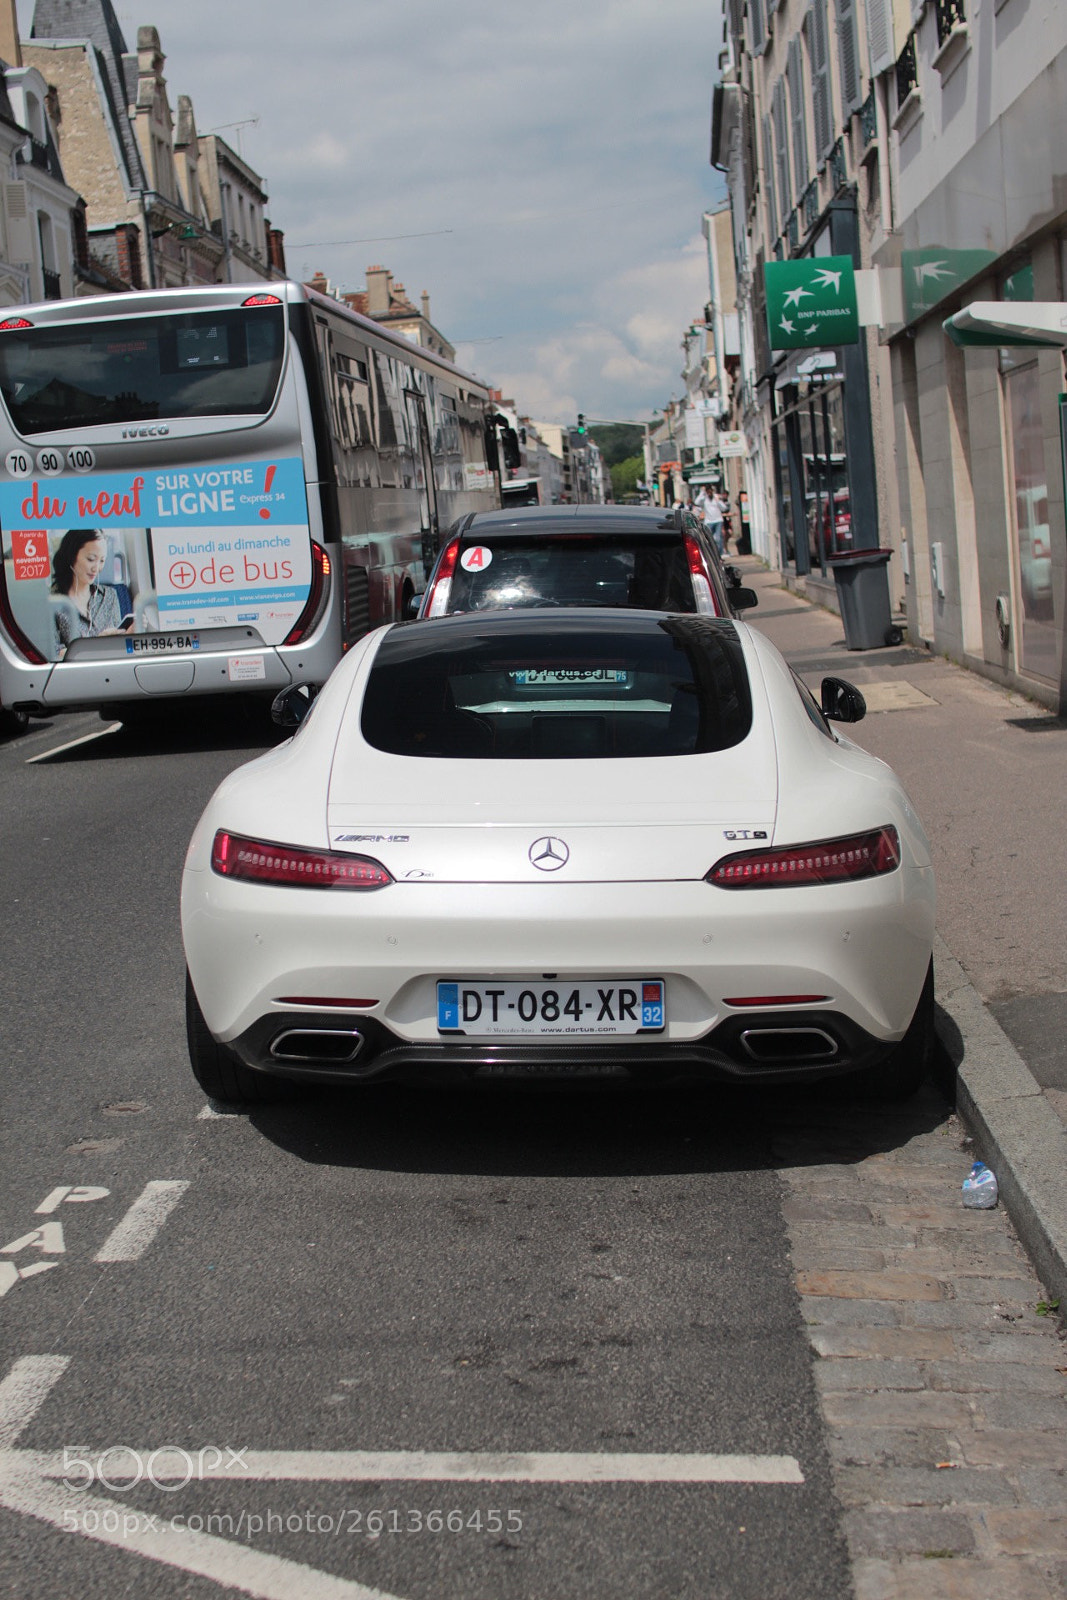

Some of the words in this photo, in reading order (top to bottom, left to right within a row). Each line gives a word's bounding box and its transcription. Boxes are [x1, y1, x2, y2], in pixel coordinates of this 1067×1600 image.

[798, 311, 815, 319] BNP
[816, 308, 851, 317] PARIBAS
[121, 424, 170, 439] IVECO
[11, 455, 27, 473] 70
[42, 453, 58, 471] 90
[69, 450, 92, 468] 100
[156, 474, 189, 491] SUR
[193, 469, 254, 488] VOTRE
[21, 482, 66, 520] du
[78, 477, 145, 519] neuf
[157, 490, 235, 517] LIGNE
[240, 494, 273, 505] express
[275, 492, 286, 501] 34
[24, 539, 37, 557] 6
[168, 544, 184, 555] Du
[187, 541, 215, 554] lundi
[218, 542, 231, 551] au
[234, 536, 291, 550] dimanche
[16, 556, 47, 564] novembre
[466, 547, 484, 567] A
[20, 564, 44, 577] 2017
[200, 557, 234, 584] de
[244, 555, 293, 581] bus
[133, 636, 192, 651] EH-994-BA
[462, 988, 639, 1022] DT-084-XR
[444, 1010, 452, 1020] F
[643, 1006, 661, 1023] 32
[541, 1026, 617, 1034] www.dartus.com
